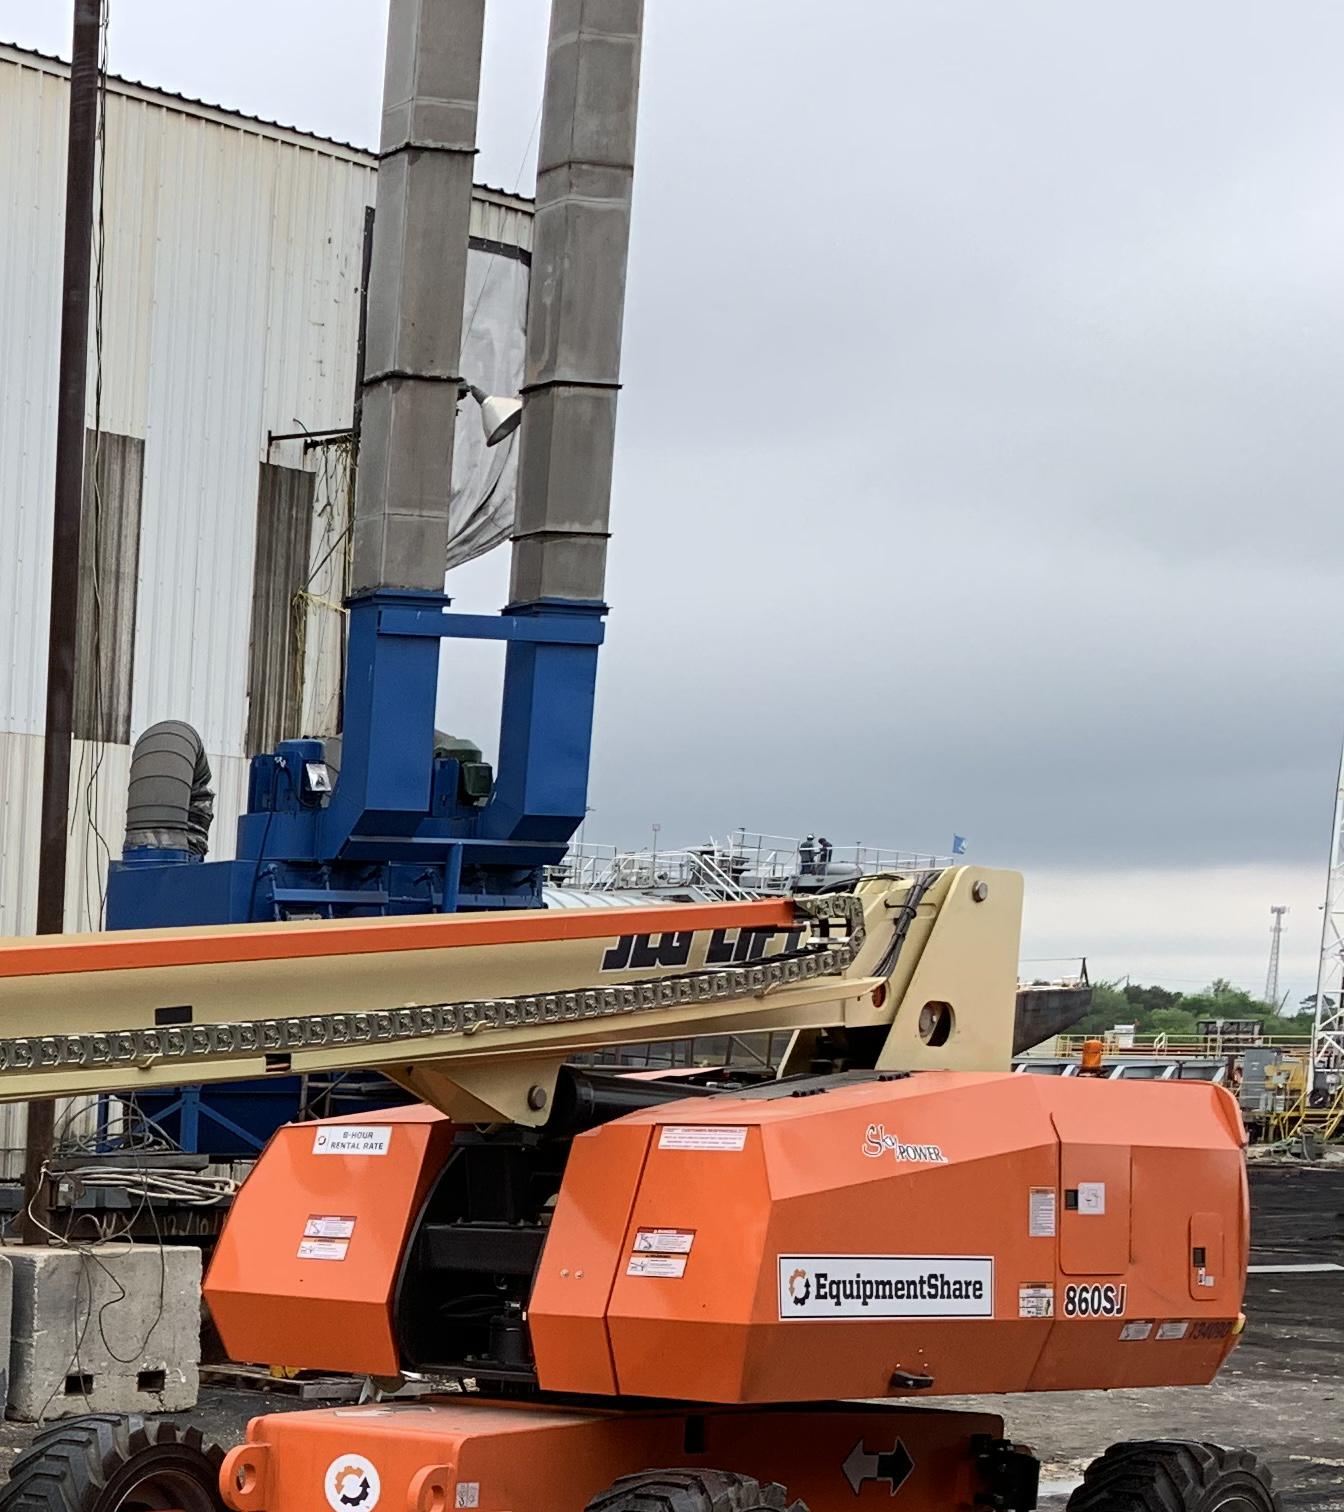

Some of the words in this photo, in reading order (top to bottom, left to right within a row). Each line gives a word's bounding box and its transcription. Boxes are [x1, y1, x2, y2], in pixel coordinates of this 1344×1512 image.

[330, 1141, 361, 1150] RENTAL
[362, 1142, 384, 1150] RATE
[813, 1271, 984, 1307] EquipmentShare
[1064, 1284, 1127, 1317] 860SJ
